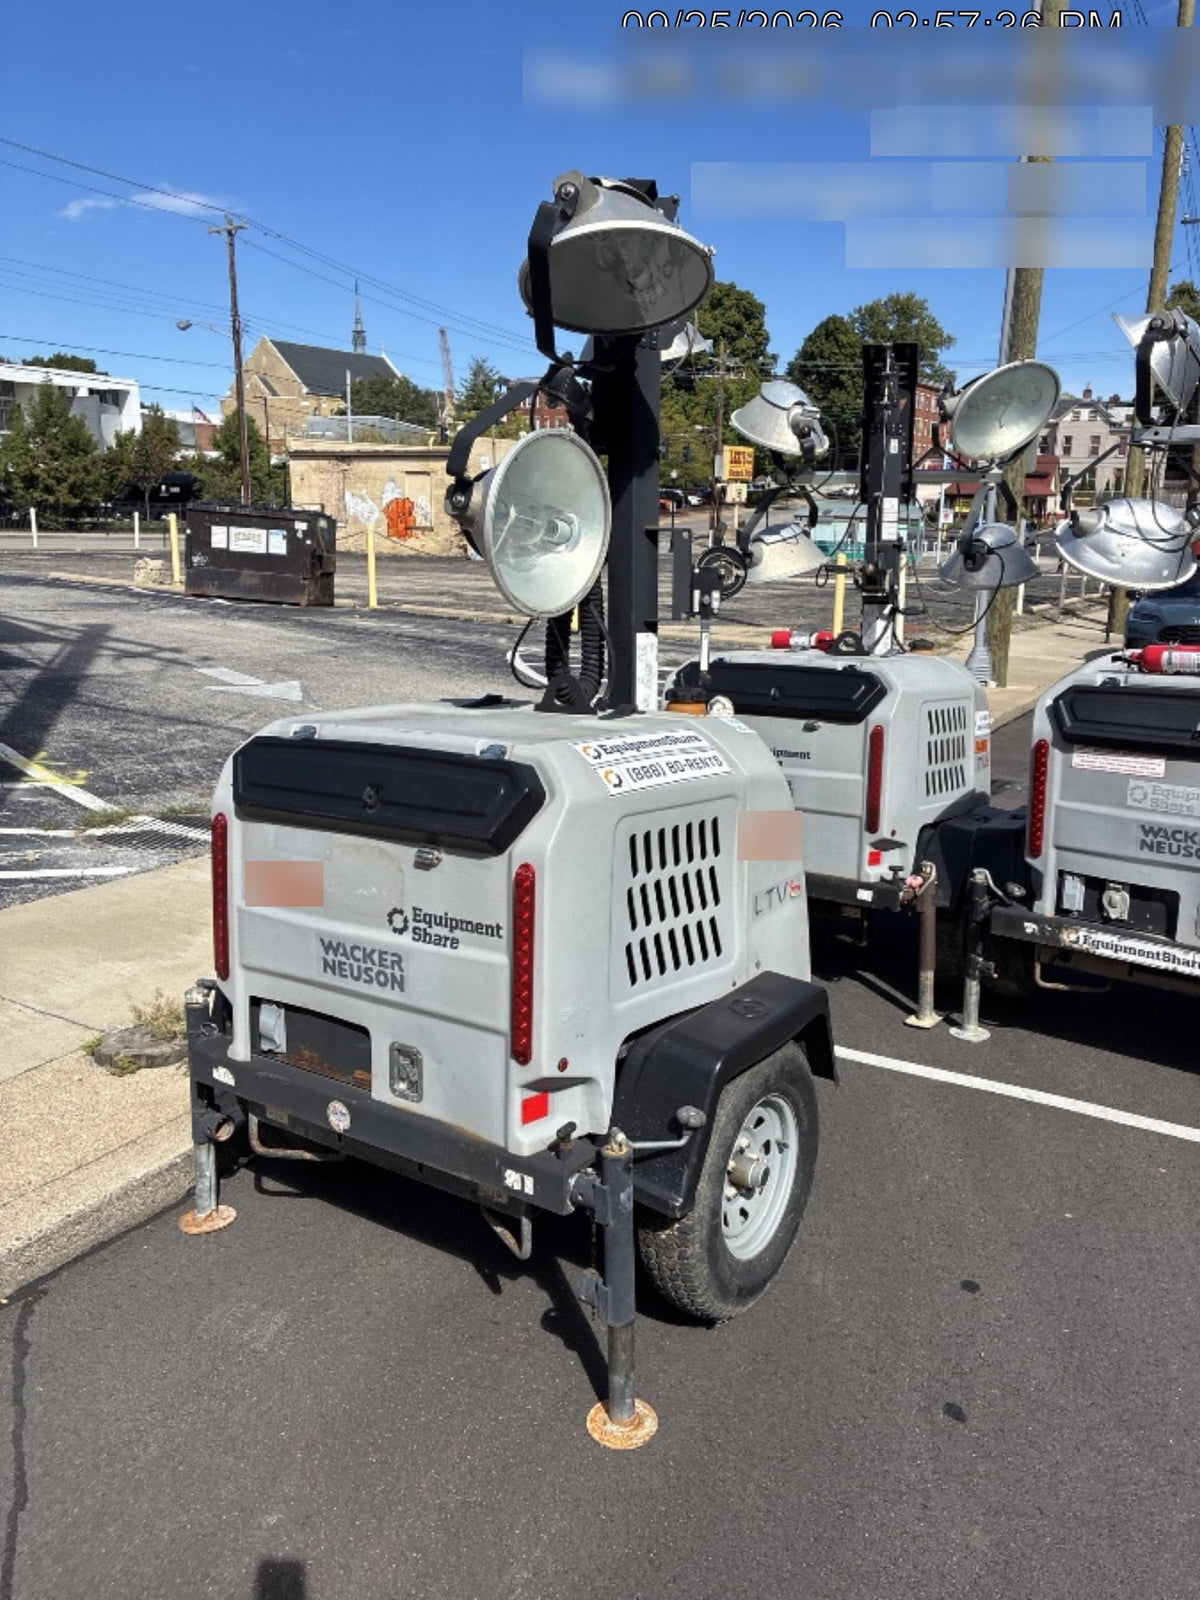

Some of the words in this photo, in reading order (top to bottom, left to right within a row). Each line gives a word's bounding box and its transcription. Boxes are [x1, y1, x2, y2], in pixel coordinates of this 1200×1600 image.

[626, 761, 666, 783] (888)
[411, 906, 503, 939] Equipment
[411, 926, 460, 950] Share
[319, 937, 404, 973] WACKER
[1082, 934, 1200, 970] EquipmentShar
[322, 957, 405, 993] NEUSON
